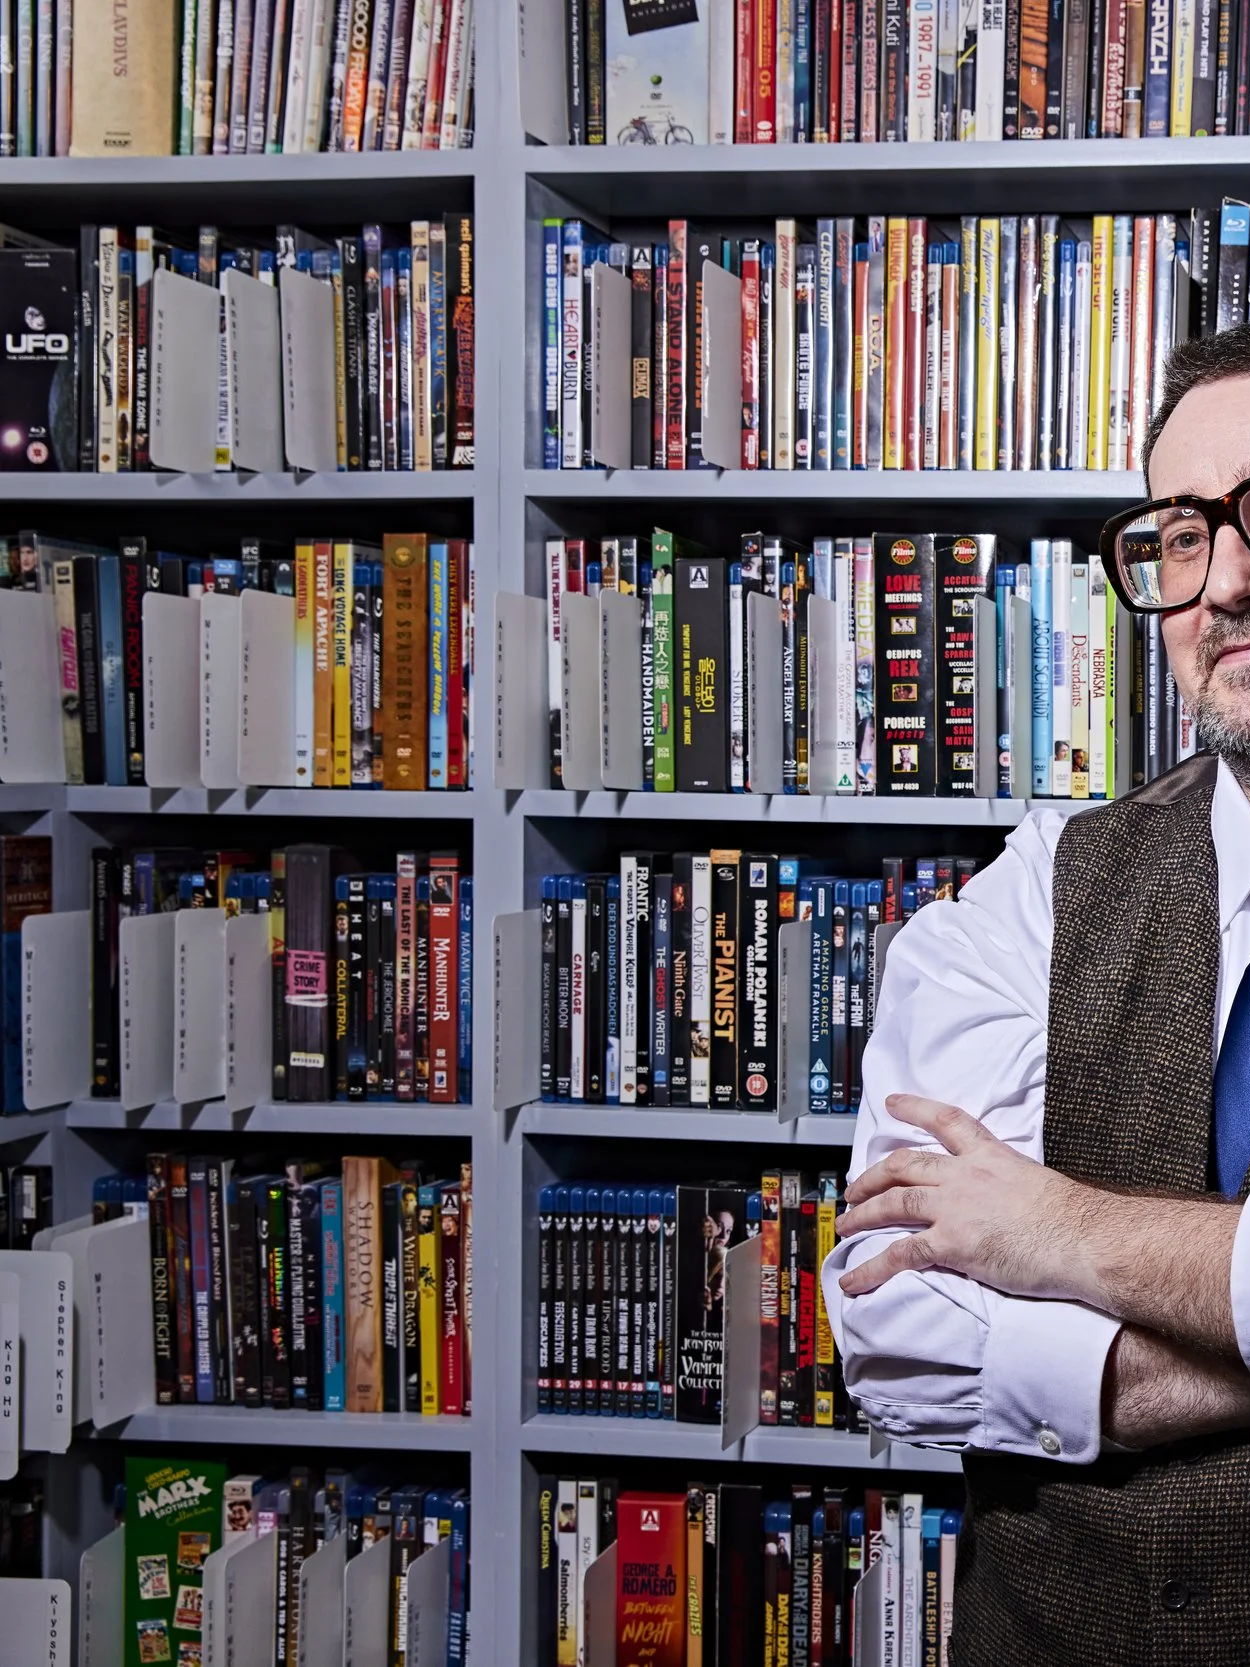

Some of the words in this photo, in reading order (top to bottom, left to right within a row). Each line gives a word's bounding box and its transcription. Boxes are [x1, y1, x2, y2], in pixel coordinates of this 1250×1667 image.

[886, 15, 900, 45] Kuti
[461, 219, 472, 241] neil
[458, 243, 472, 295] gaiman's
[889, 228, 906, 282] DILLINGER
[669, 282, 682, 349] STAND
[6, 333, 69, 354] UFO
[137, 348, 146, 370] THE
[869, 316, 881, 376] D.O.A.
[137, 372, 146, 398] WAR
[635, 361, 649, 399] CLIMAX
[669, 356, 681, 426] ALONE
[136, 400, 146, 429] ZONE
[125, 564, 140, 624] PANIC
[317, 554, 328, 600] FORT
[335, 568, 346, 592] LONG
[396, 578, 413, 611] THE
[885, 575, 921, 593] LOVE
[885, 593, 923, 604] MEETINGS
[336, 597, 346, 634] VOYAGE
[857, 580, 873, 633] MEDEA
[127, 628, 141, 688] ROOM
[316, 606, 327, 672] APACHE
[336, 638, 346, 667] HOME
[886, 650, 922, 660] OEDIPUS
[396, 621, 413, 721] SEARCHERS
[698, 657, 716, 713] 올드보이
[784, 646, 794, 685] ANGEL
[889, 659, 920, 677] REX
[1071, 635, 1086, 707] Descendants
[1093, 648, 1105, 699] NEBRASKA
[642, 644, 655, 747] HANDMAIDEN
[784, 687, 794, 724] HEART
[883, 716, 926, 730] PORCILE
[401, 886, 412, 905] THE
[608, 903, 617, 922] DER
[637, 866, 649, 922] FRANTIC
[401, 909, 412, 934] LAST
[608, 923, 617, 944] TOD
[715, 912, 726, 938] THE
[755, 899, 768, 960] ROMAN
[352, 914, 362, 980] HEAT
[401, 939, 412, 952] OF
[401, 956, 412, 976] THE
[461, 931, 471, 973] MIAMI
[608, 944, 617, 966] UND
[656, 946, 666, 968] THE
[812, 932, 821, 979] ARETHA
[821, 939, 829, 992] AMAZING
[417, 937, 427, 1033] MANHUNTER
[433, 938, 450, 1022] MANHUNTER
[559, 967, 569, 998] BITTER
[573, 953, 582, 1015] CARNAGE
[608, 967, 617, 986] DAS
[656, 967, 666, 1009] GHOST
[674, 950, 686, 987] Ninth
[746, 945, 756, 1001] COLLECTION
[337, 959, 347, 1040] COLLATERAL
[400, 978, 412, 1036] MOHICANS
[461, 977, 471, 1006] VICE
[559, 999, 569, 1028] MOON
[608, 987, 619, 1035] MÄDCHEN
[673, 989, 686, 1017] Gate
[714, 940, 735, 1043] PIANIST
[753, 967, 767, 1048] POLANSKI
[812, 984, 821, 1042] FRANKLIN
[656, 1010, 666, 1055] WRITER
[821, 996, 829, 1036] GRACE
[404, 1218, 413, 1232] THE
[359, 1201, 374, 1309] SHADOW
[404, 1237, 416, 1283] WHITE
[153, 1257, 168, 1301] BORN
[385, 1258, 397, 1300] TRIPLE
[761, 1264, 778, 1318] DESPERADO
[57, 1280, 66, 1357] Stephen
[155, 1313, 171, 1359] FIGHT
[385, 1302, 397, 1348] THREAT
[404, 1290, 416, 1347] DRAGON
[555, 1301, 564, 1363] FASCINATION
[799, 1270, 814, 1369] MACHETE
[4, 1340, 12, 1385] King
[3, 1396, 12, 1418] Hu
[56, 1369, 64, 1414] King
[138, 1475, 213, 1519] MARX
[541, 1490, 551, 1522] QUEEN
[706, 1492, 716, 1543] CREEPSHOW
[541, 1523, 551, 1569] CHRISTINA
[559, 1559, 571, 1641] Salmonberries
[621, 1577, 677, 1597] ROMERO
[624, 1601, 676, 1615] BETWEEN
[812, 1552, 822, 1643] KNIGHTRIDERS
[450, 1611, 461, 1659] FALLOUT
[621, 1617, 680, 1645] NIGHT
